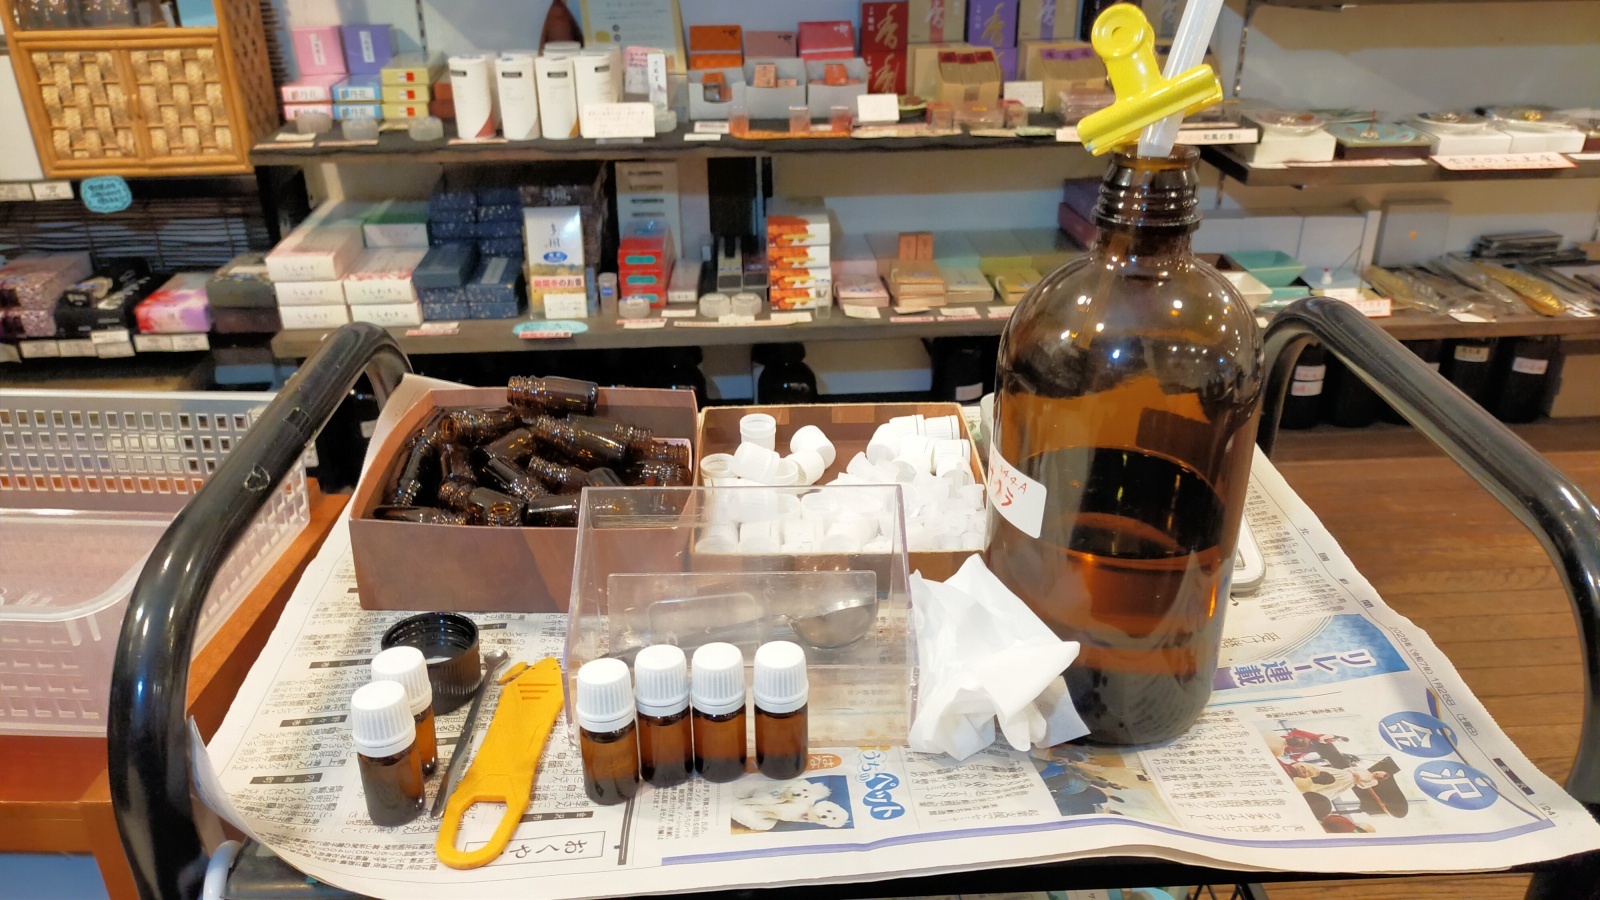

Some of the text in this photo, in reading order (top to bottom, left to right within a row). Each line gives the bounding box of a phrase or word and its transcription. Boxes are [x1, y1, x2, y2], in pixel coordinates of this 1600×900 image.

[1234, 650, 1373, 687] リレー連載
[859, 751, 902, 818] うちのペット
